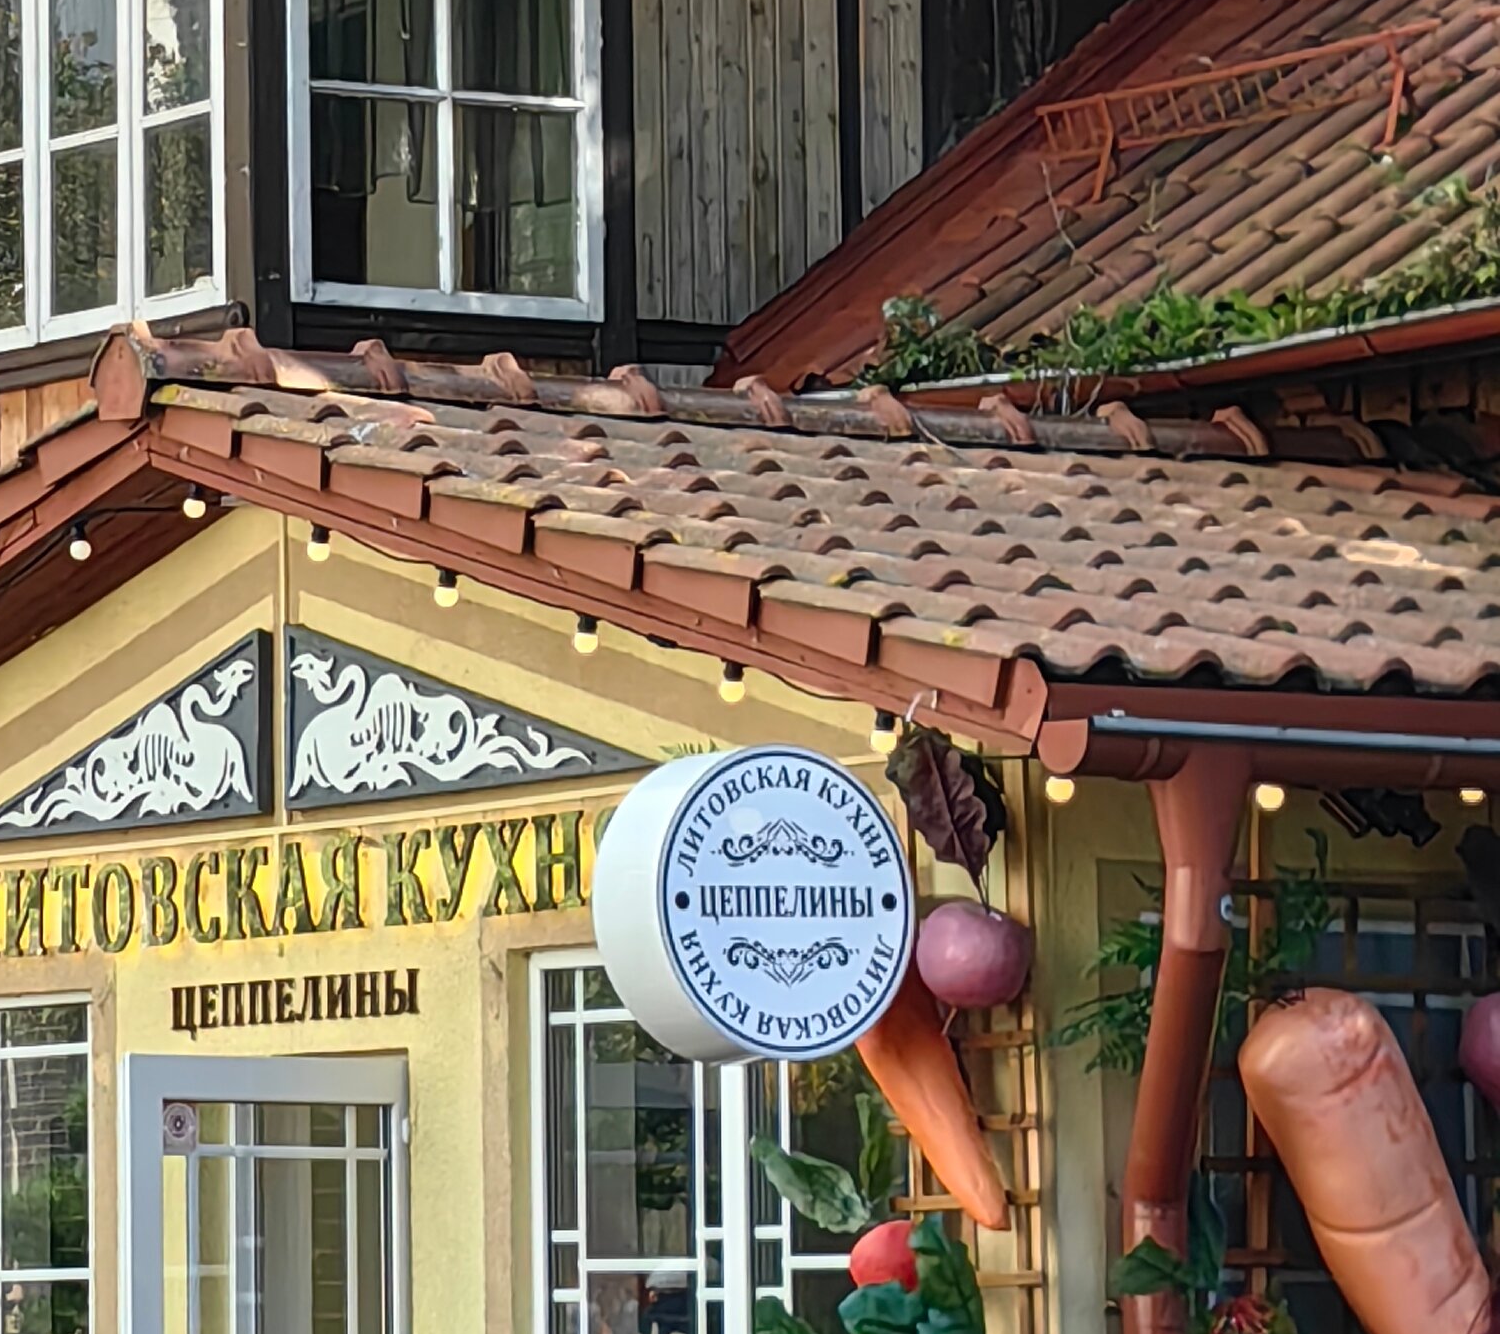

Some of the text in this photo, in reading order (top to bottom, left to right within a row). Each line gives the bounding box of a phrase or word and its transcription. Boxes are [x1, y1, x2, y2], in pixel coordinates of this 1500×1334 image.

[383, 805, 617, 927] КУХН
[676, 764, 892, 877] ЛИТОВСКАЯ КУХНЯ
[699, 884, 874, 926] ЦЕППЕЛИНЫ
[170, 969, 421, 1039] ЦЕППЕЛИНЫ
[679, 929, 895, 1041] ЛИТОВСКАЯ КУХНЯ
